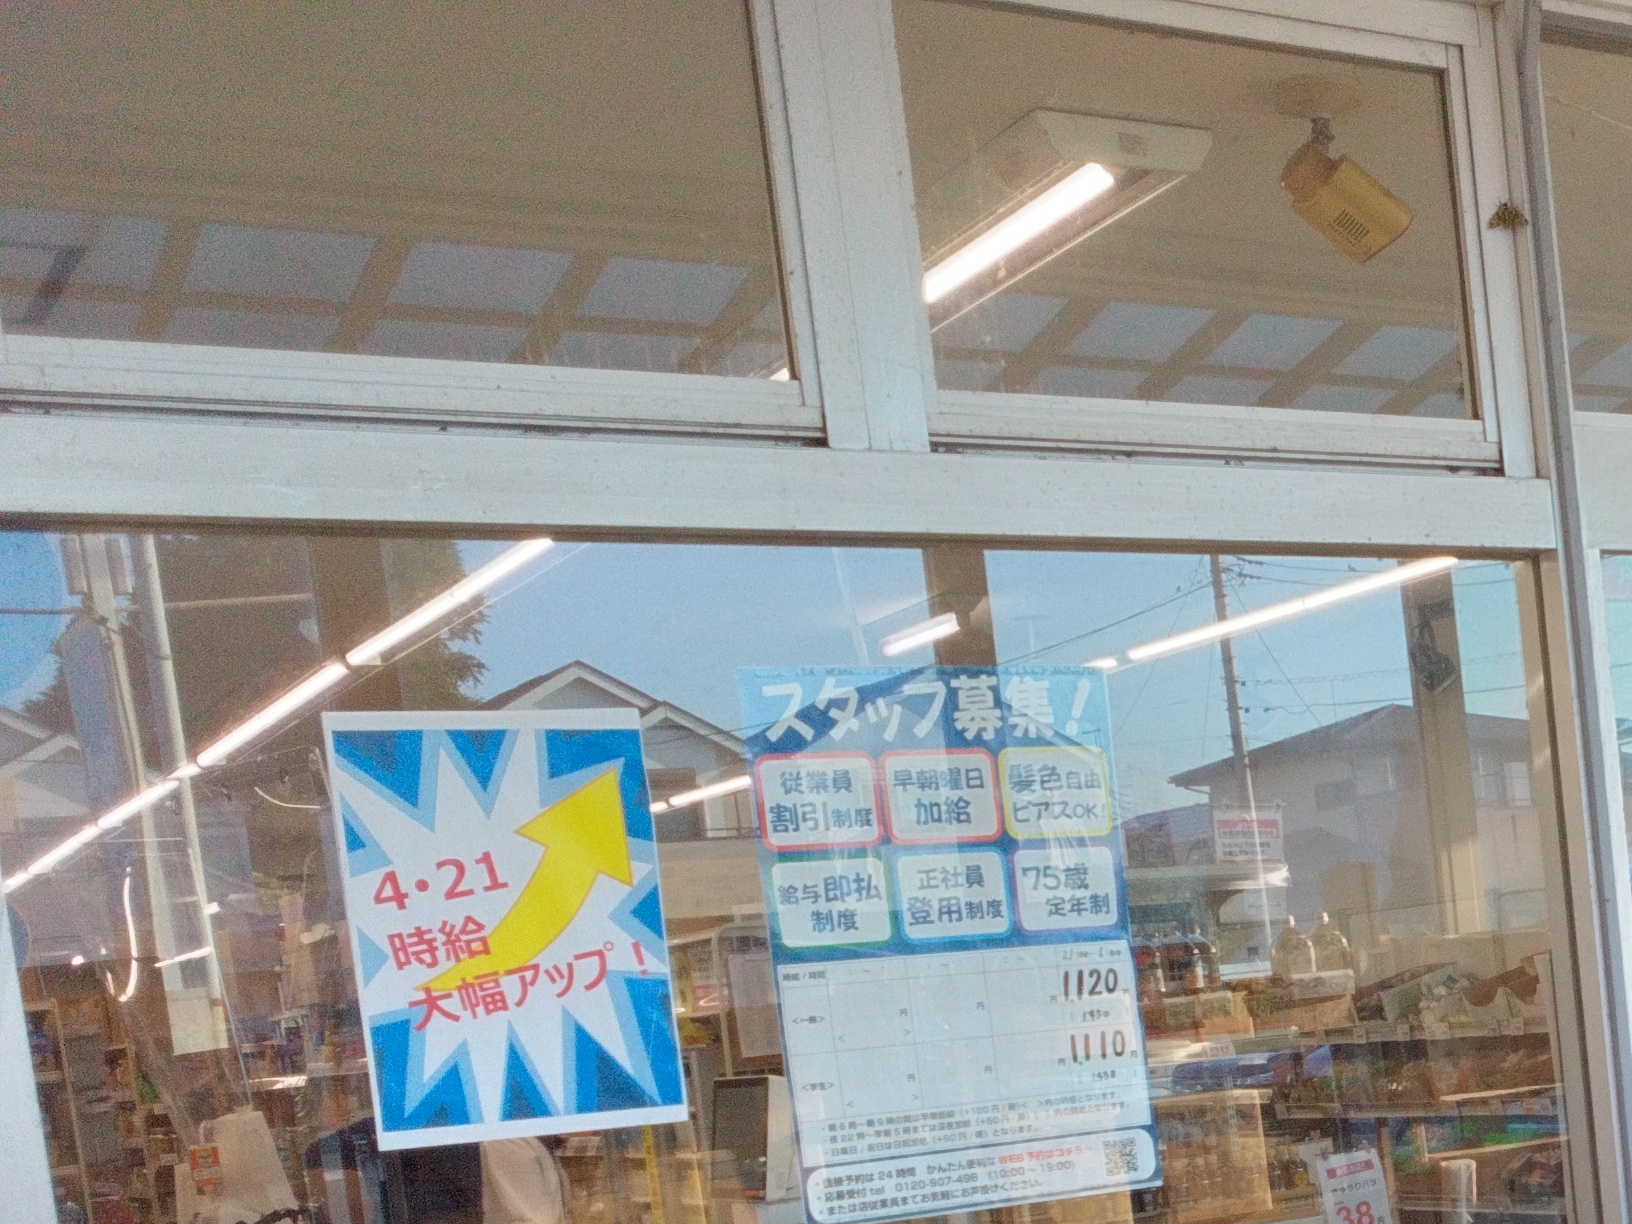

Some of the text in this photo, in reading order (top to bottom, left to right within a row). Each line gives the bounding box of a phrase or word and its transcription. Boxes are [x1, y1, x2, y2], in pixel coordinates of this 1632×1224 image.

[779, 769, 854, 795] 従業員
[1008, 764, 1101, 794] 髪色自由
[770, 800, 874, 834] 割引制度
[914, 796, 972, 826] 加給
[778, 872, 883, 906] 給与即払
[917, 864, 985, 891] 正社員
[1021, 863, 1089, 892] 75歳
[810, 908, 860, 933] 制度
[906, 895, 1005, 926] 登用制度
[1045, 893, 1111, 918] 定年制
[388, 915, 491, 970] 時給
